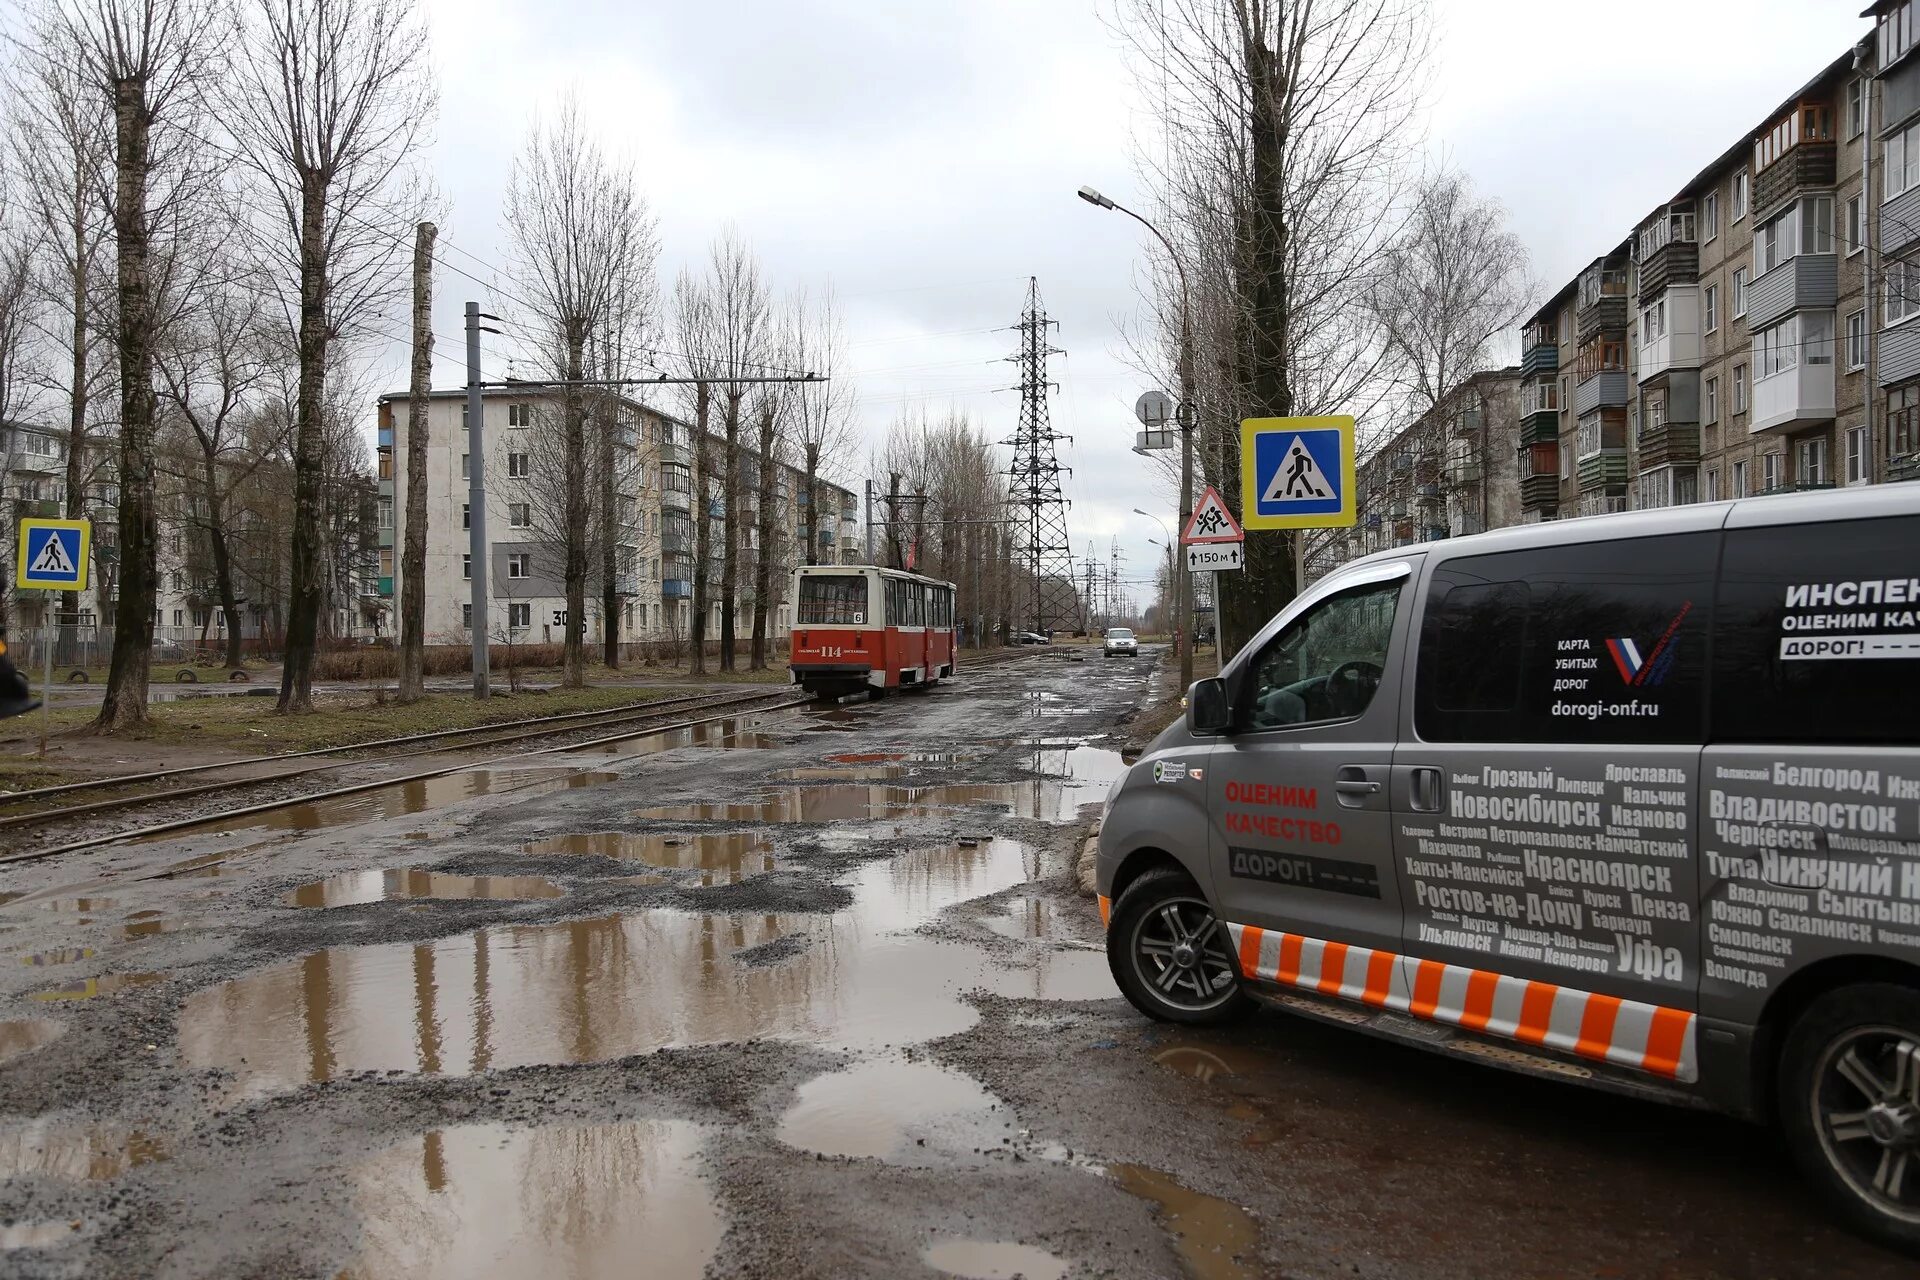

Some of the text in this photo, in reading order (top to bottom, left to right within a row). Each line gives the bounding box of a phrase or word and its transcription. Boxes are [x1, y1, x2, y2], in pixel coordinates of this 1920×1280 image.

[1199, 552, 1218, 563] 150
[855, 613, 862, 622] 6
[1782, 612, 1878, 631] ОЦЕНИМ
[821, 646, 841, 658] 114
[1558, 640, 1590, 650] КАРТА
[1784, 640, 1864, 656] ДОРОГ!
[1555, 658, 1598, 669] УБИТЫХ
[1553, 679, 1588, 692] ДОРОГ
[1551, 699, 1659, 720] dorogi-onf.ru
[1483, 765, 1554, 789] Грозный
[1556, 777, 1604, 796] Липецк
[1605, 763, 1686, 784] Ярославль
[1773, 762, 1880, 795] Белгород
[1225, 781, 1318, 810] ОЦЕНИМ
[1450, 790, 1686, 829] Новосибирск Иваново
[1623, 786, 1686, 806] Нальчик
[1710, 789, 1897, 833] Владивосток
[1226, 812, 1342, 845] КАЧЕСТВО
[1439, 823, 1488, 839] Кострома
[1490, 825, 1688, 858] Петропавловск-Камчатский
[1716, 820, 1816, 850] Черкесск
[1233, 852, 1313, 882] ДОРОГ!
[1405, 857, 1525, 887] Ханты-Мансийск
[1418, 838, 1482, 859] Махачкала
[1523, 849, 1673, 893] Красноярск
[1706, 850, 1759, 879] Тула
[1760, 848, 1893, 897] Нижний
[1414, 879, 1652, 936] Ростов-на-Дону Барнаул
[1583, 889, 1622, 909] Курск
[1630, 892, 1690, 922] Пенза
[1728, 883, 1808, 912] Владимир
[1461, 915, 1499, 934] Якутск
[1504, 921, 1577, 950] Йошкар-Ола
[1711, 899, 1763, 927] Южно
[1768, 908, 1873, 944] Сахалинск
[1419, 923, 1683, 982] Ульяновск Майкоп Кемерово Уфа
[1708, 922, 1792, 955] Смоленск
[1706, 958, 1768, 989] Вологда
